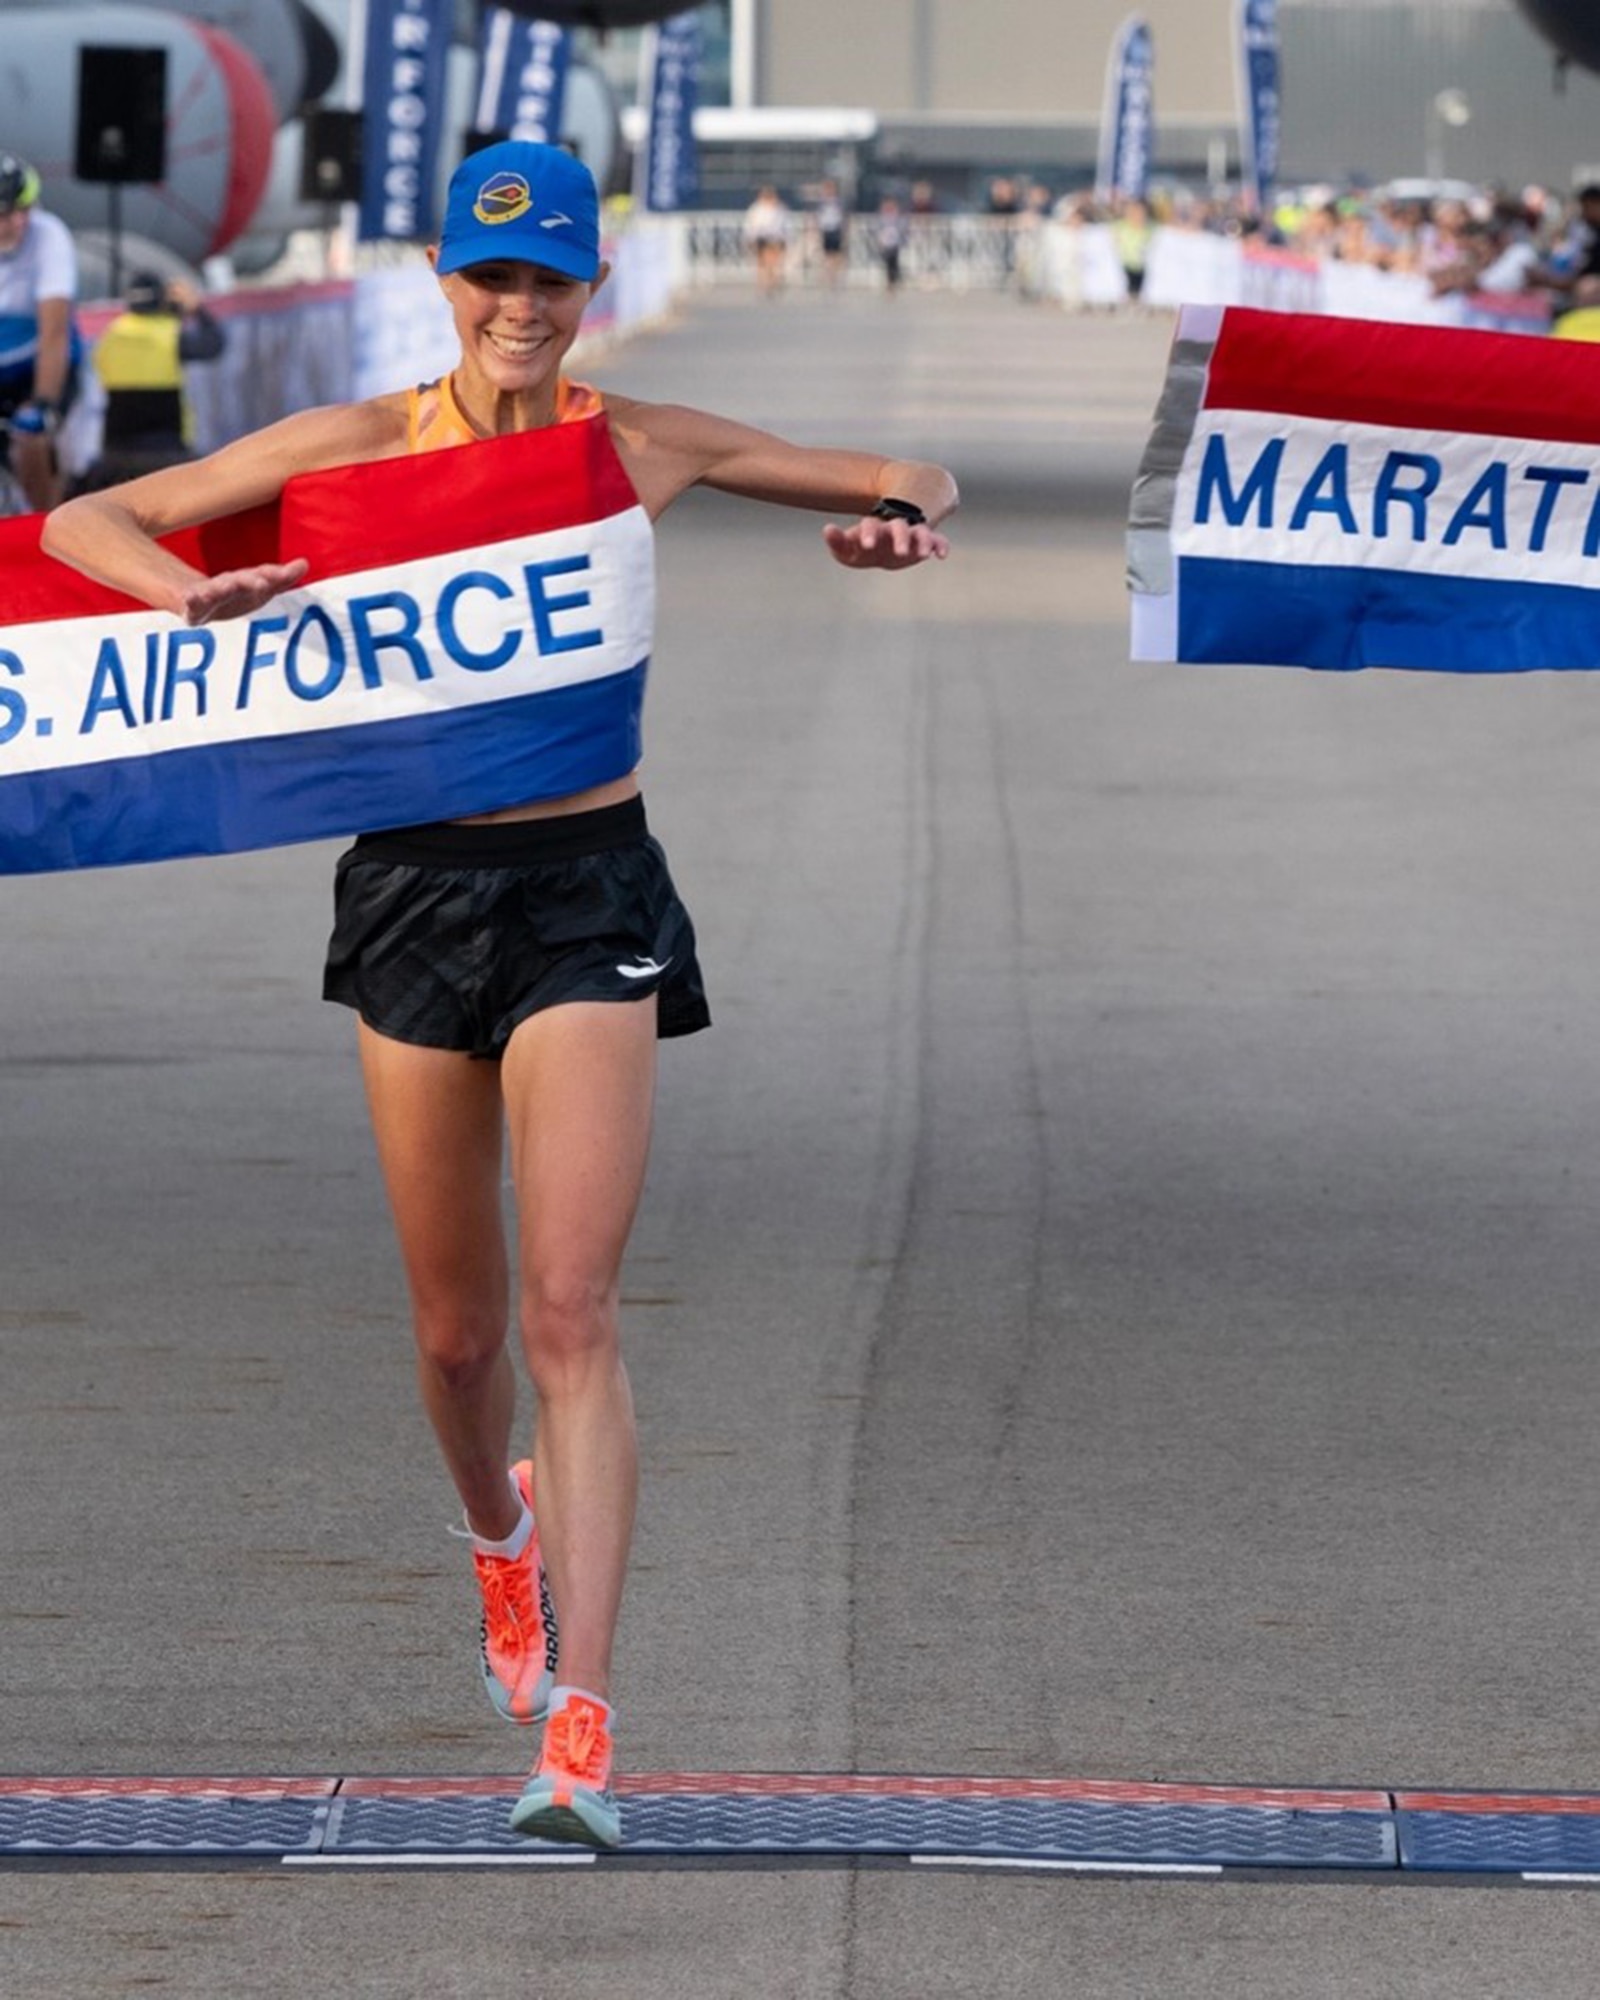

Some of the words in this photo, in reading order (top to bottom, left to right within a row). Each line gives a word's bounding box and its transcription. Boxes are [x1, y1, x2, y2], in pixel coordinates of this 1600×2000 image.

[383, 57, 427, 237] FORCE
[1193, 433, 1600, 558] MARAT
[78, 628, 217, 734] AIR
[235, 554, 603, 709] FORCE
